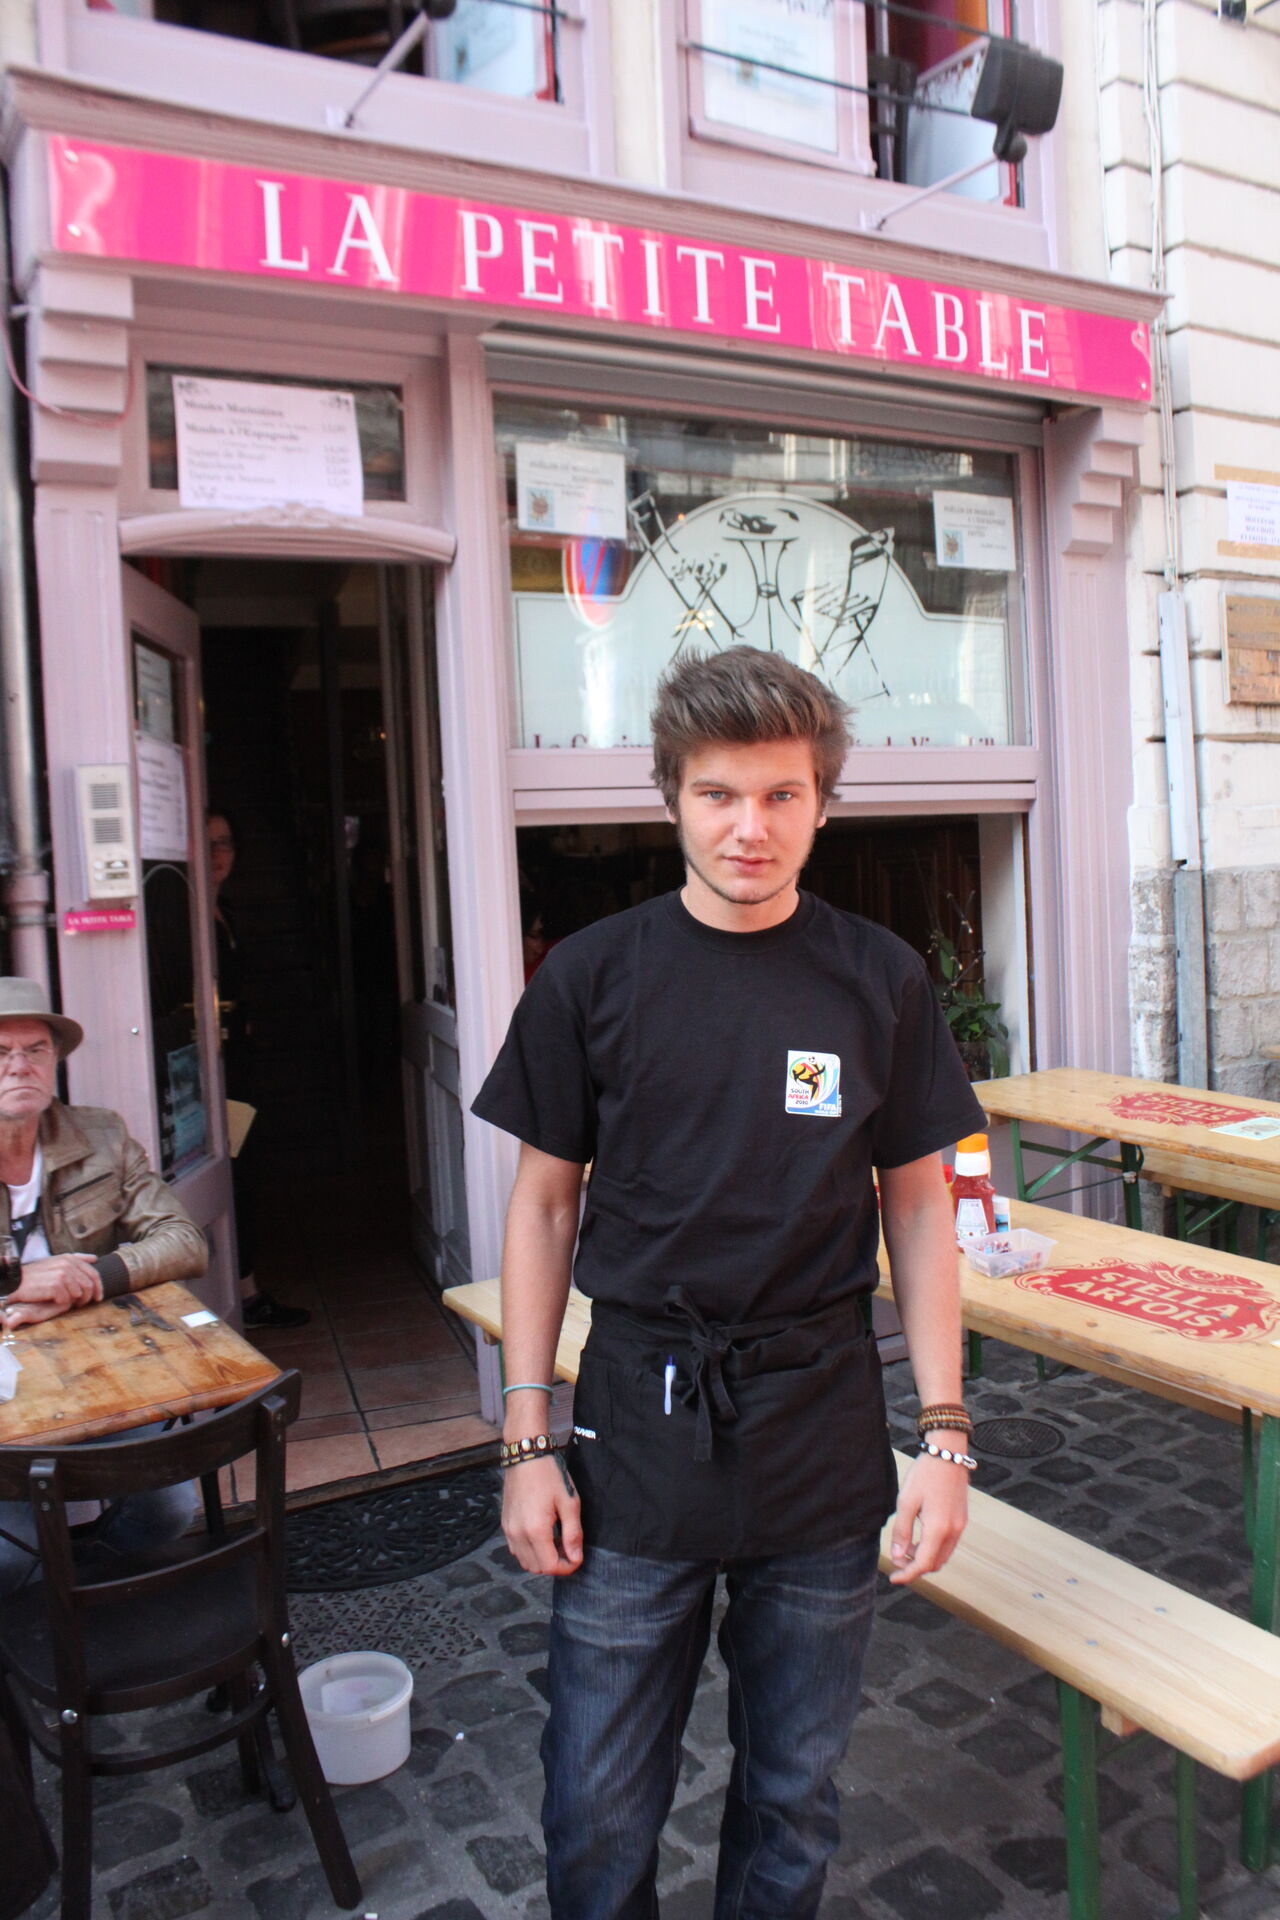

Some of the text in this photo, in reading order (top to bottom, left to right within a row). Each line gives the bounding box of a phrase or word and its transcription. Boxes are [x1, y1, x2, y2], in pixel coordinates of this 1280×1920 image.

[256, 180, 1051, 379] LA PETITE TABLE
[1060, 1281, 1220, 1329] ARTOIS
[1092, 1271, 1239, 1319] STELLA
